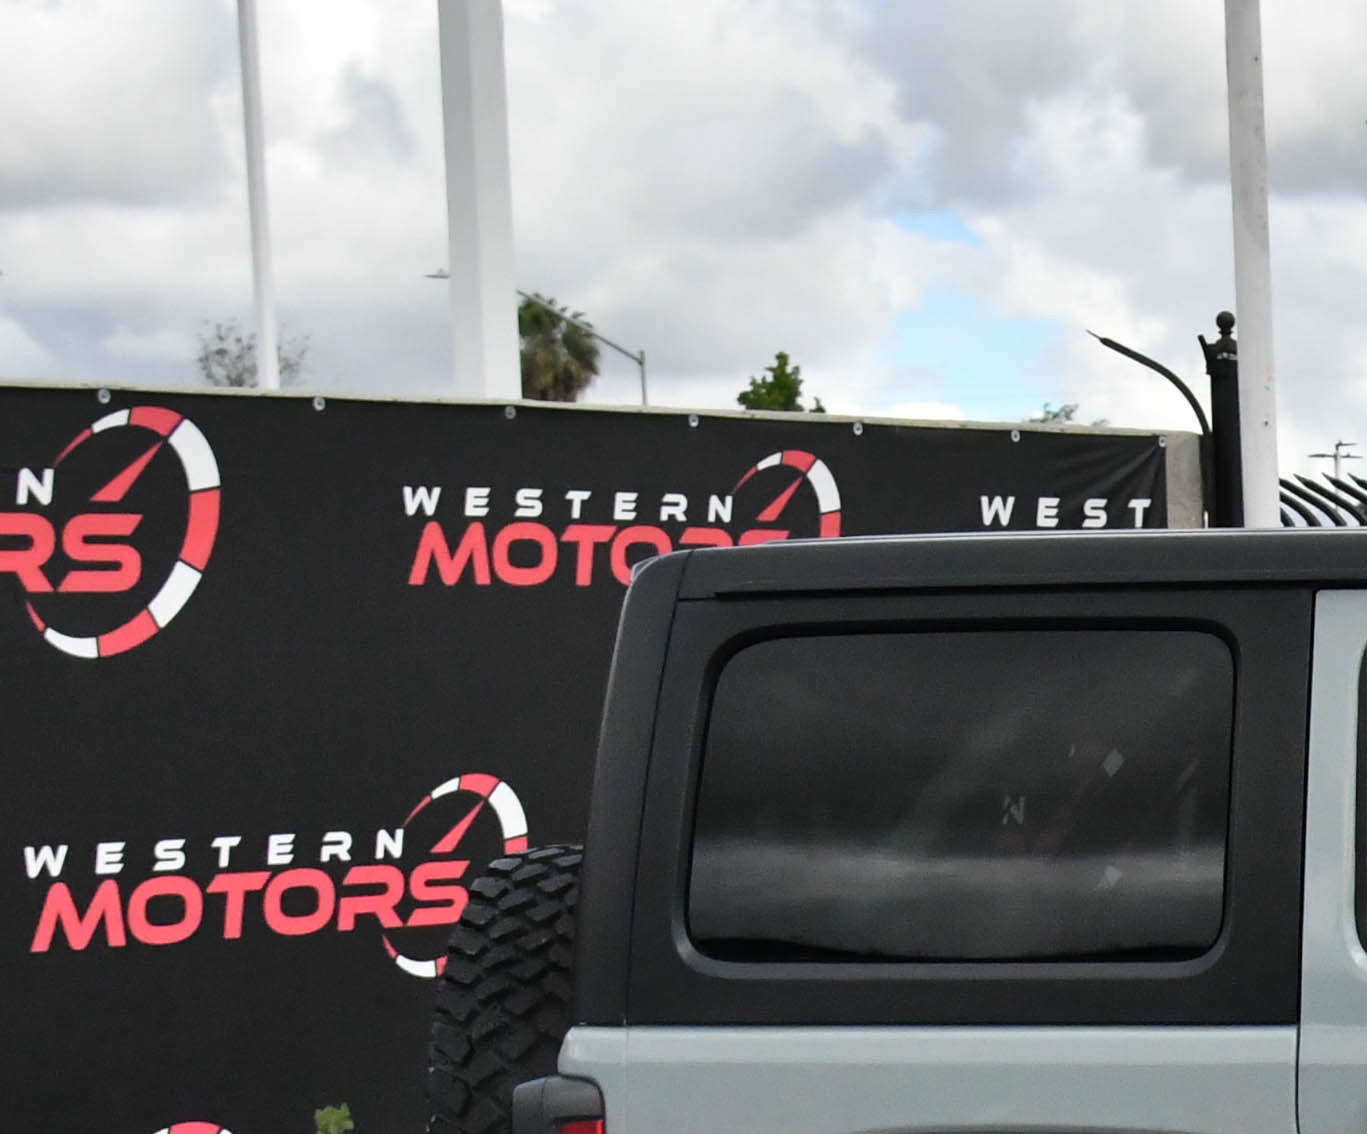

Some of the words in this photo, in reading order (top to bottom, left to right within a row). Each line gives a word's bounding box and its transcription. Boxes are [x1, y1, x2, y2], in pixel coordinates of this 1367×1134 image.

[402, 486, 734, 523] WESTERN
[980, 496, 1152, 528] WEST
[407, 521, 791, 587] MOTO
[24, 828, 405, 879] WESTERN
[30, 859, 471, 953] MOTORS
